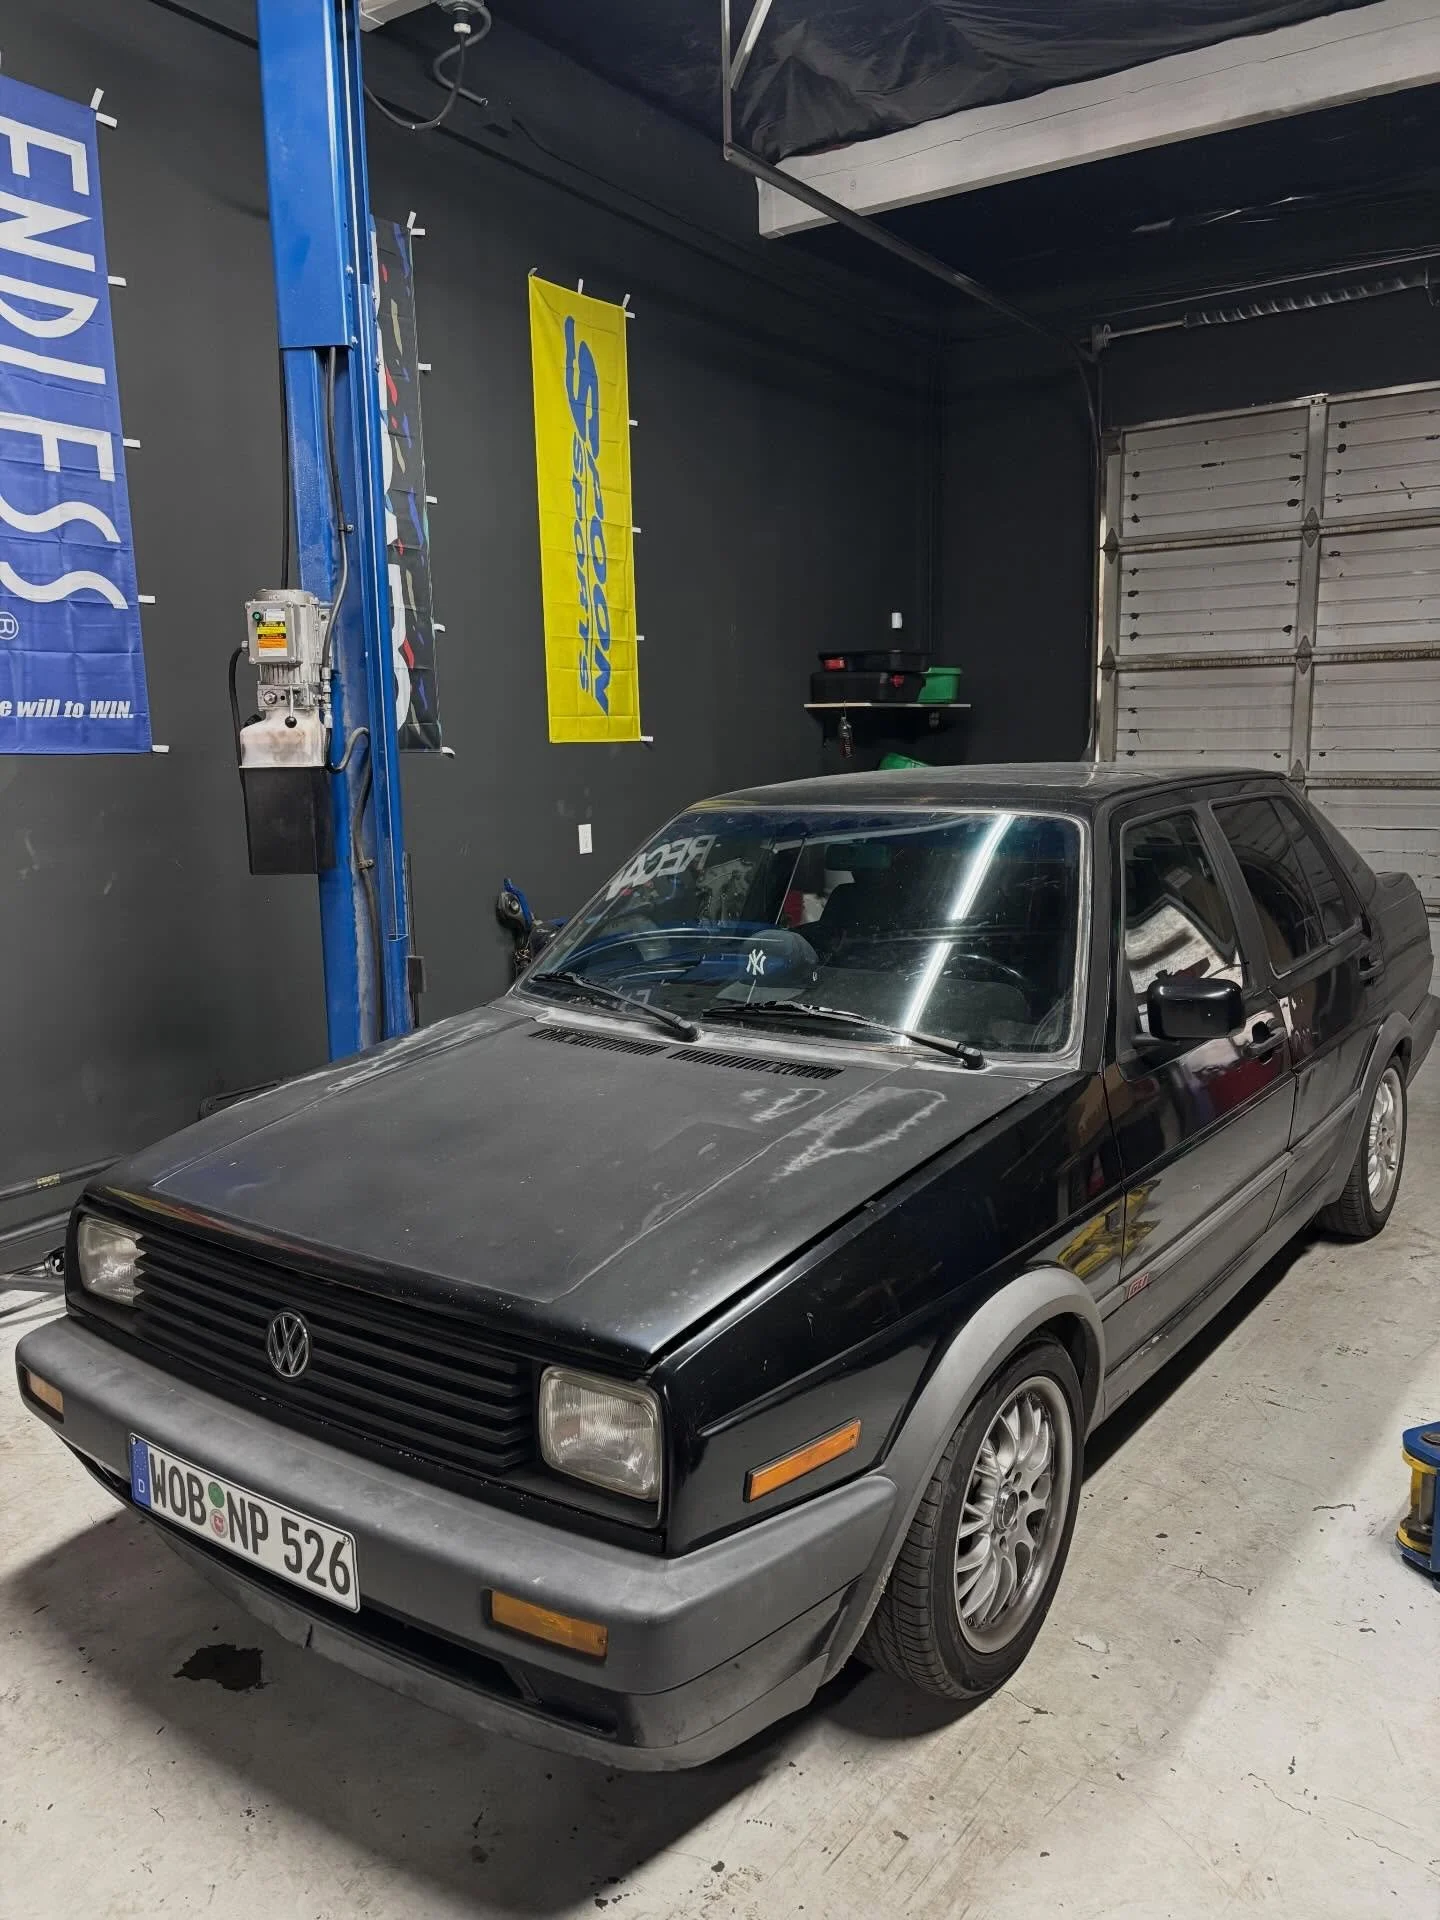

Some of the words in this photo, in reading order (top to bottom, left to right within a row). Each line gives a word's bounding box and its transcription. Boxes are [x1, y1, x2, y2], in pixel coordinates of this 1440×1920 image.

[573, 433, 590, 692] SPORTS
[17, 699, 60, 718] will
[64, 701, 84, 718] to
[90, 700, 134, 719] WIN.
[138, 1478, 146, 1493] D
[150, 1453, 207, 1526] WOB
[226, 1492, 269, 1555] NP
[281, 1516, 350, 1596] 526
